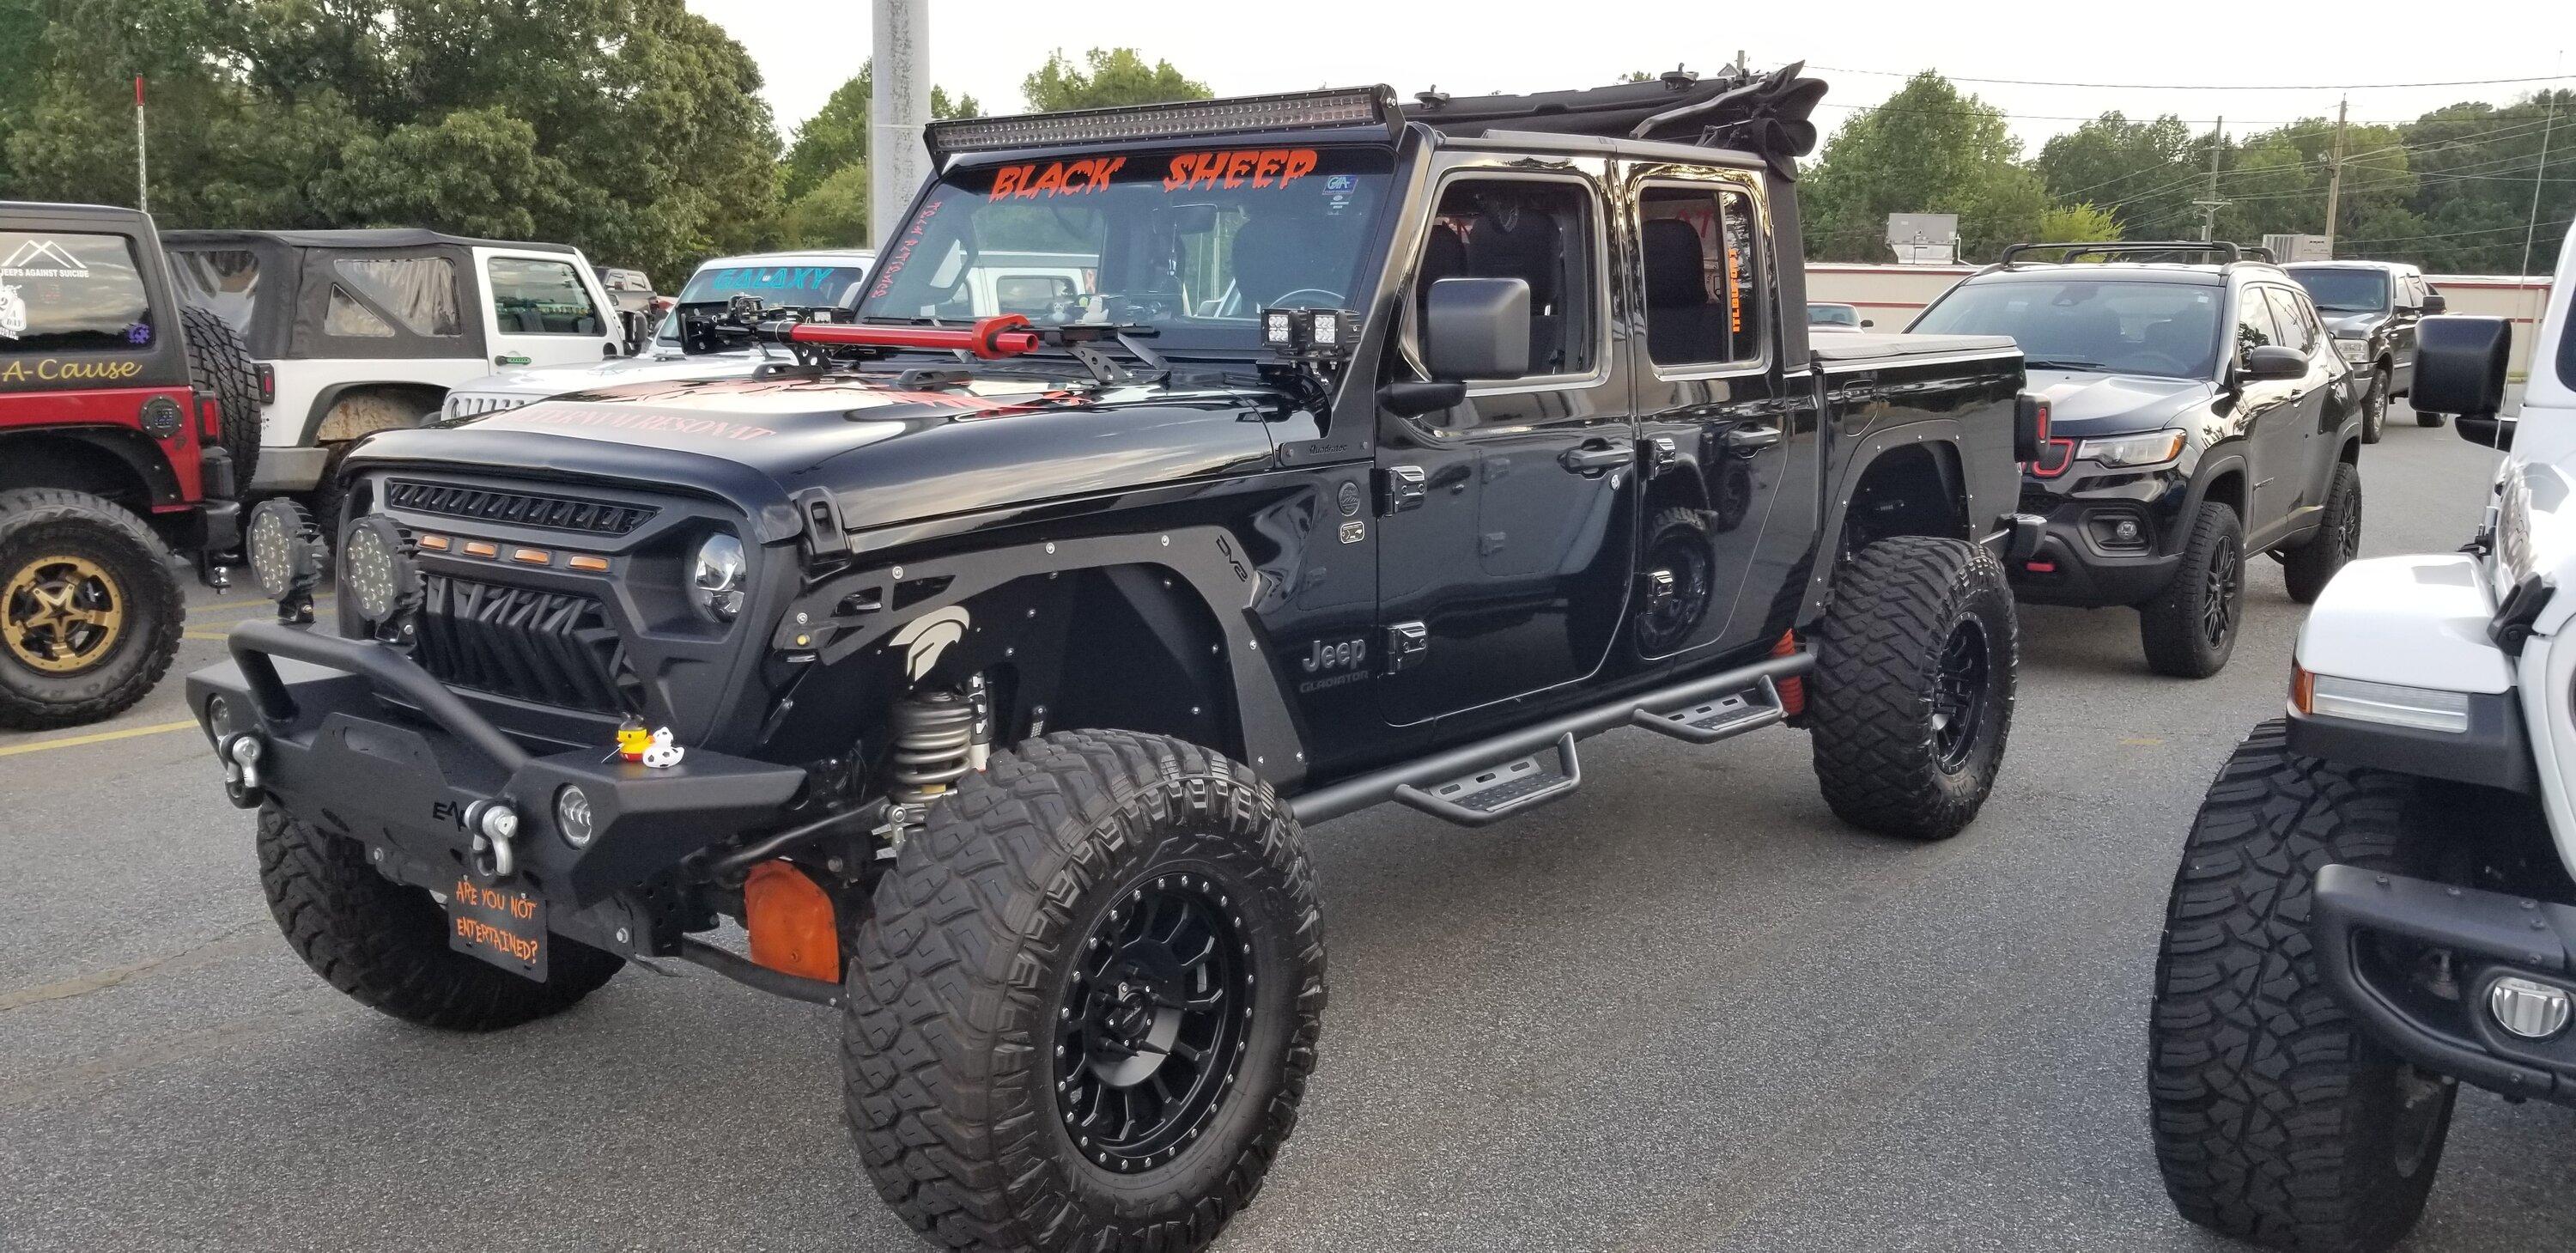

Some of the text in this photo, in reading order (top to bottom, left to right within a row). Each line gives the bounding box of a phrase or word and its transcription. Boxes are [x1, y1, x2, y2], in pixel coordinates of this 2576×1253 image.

[988, 149, 1318, 204] BLACK SHEEP
[0, 268, 89, 278] JEEPS AGAINST SUICIDE
[714, 267, 835, 289] GALAXY
[1303, 639, 1366, 672] Jeep
[1299, 670, 1369, 693] GLADIATOR
[456, 881, 537, 920] ARE YOU NOT
[456, 916, 538, 964] ENTERTAINED?
